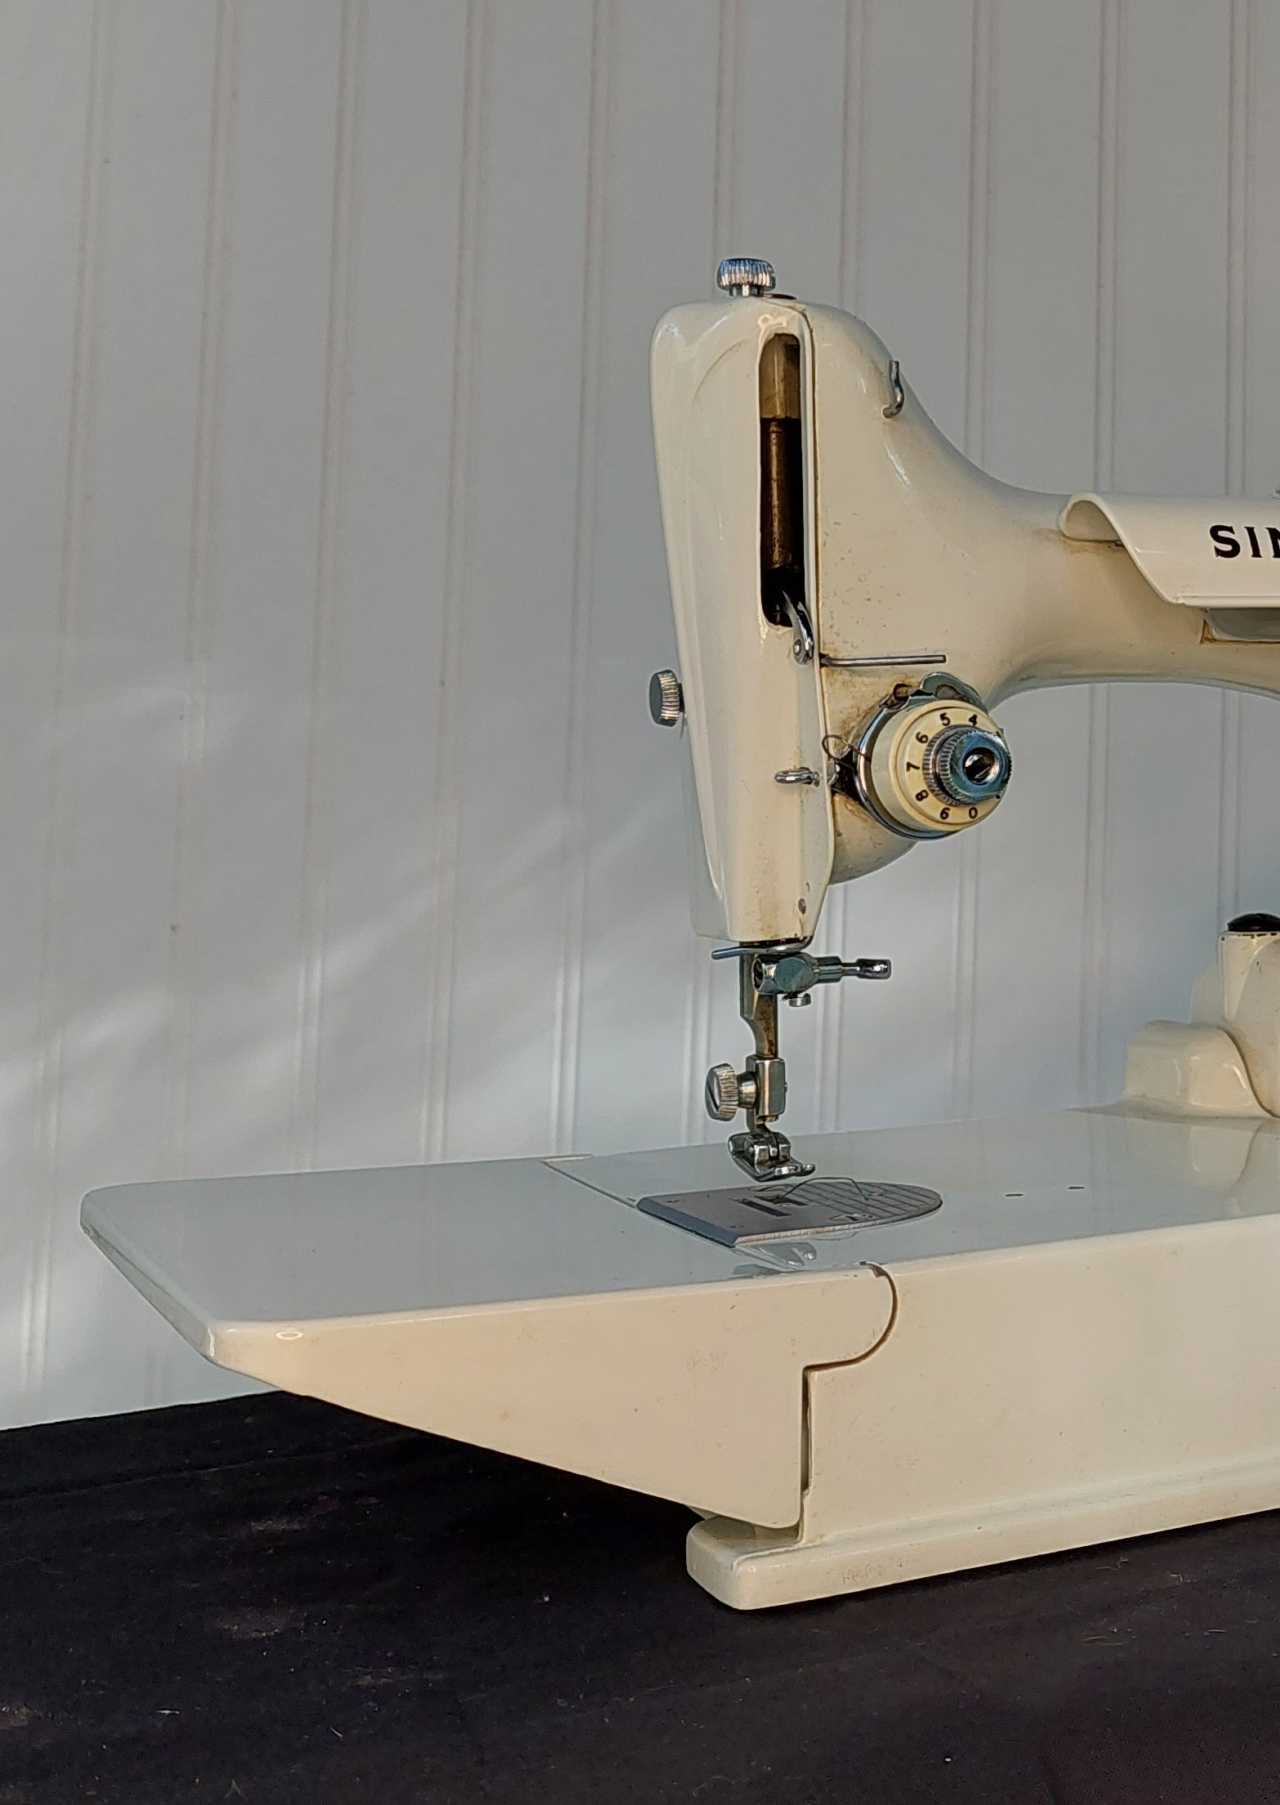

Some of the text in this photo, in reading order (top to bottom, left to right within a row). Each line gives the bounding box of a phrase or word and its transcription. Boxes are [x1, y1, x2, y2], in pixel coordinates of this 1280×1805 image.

[939, 712, 951, 726] 5
[968, 714, 978, 727] 4
[915, 731, 929, 744] 6
[906, 761, 920, 772] 7
[915, 789, 929, 802] 8
[968, 807, 978, 819] 0
